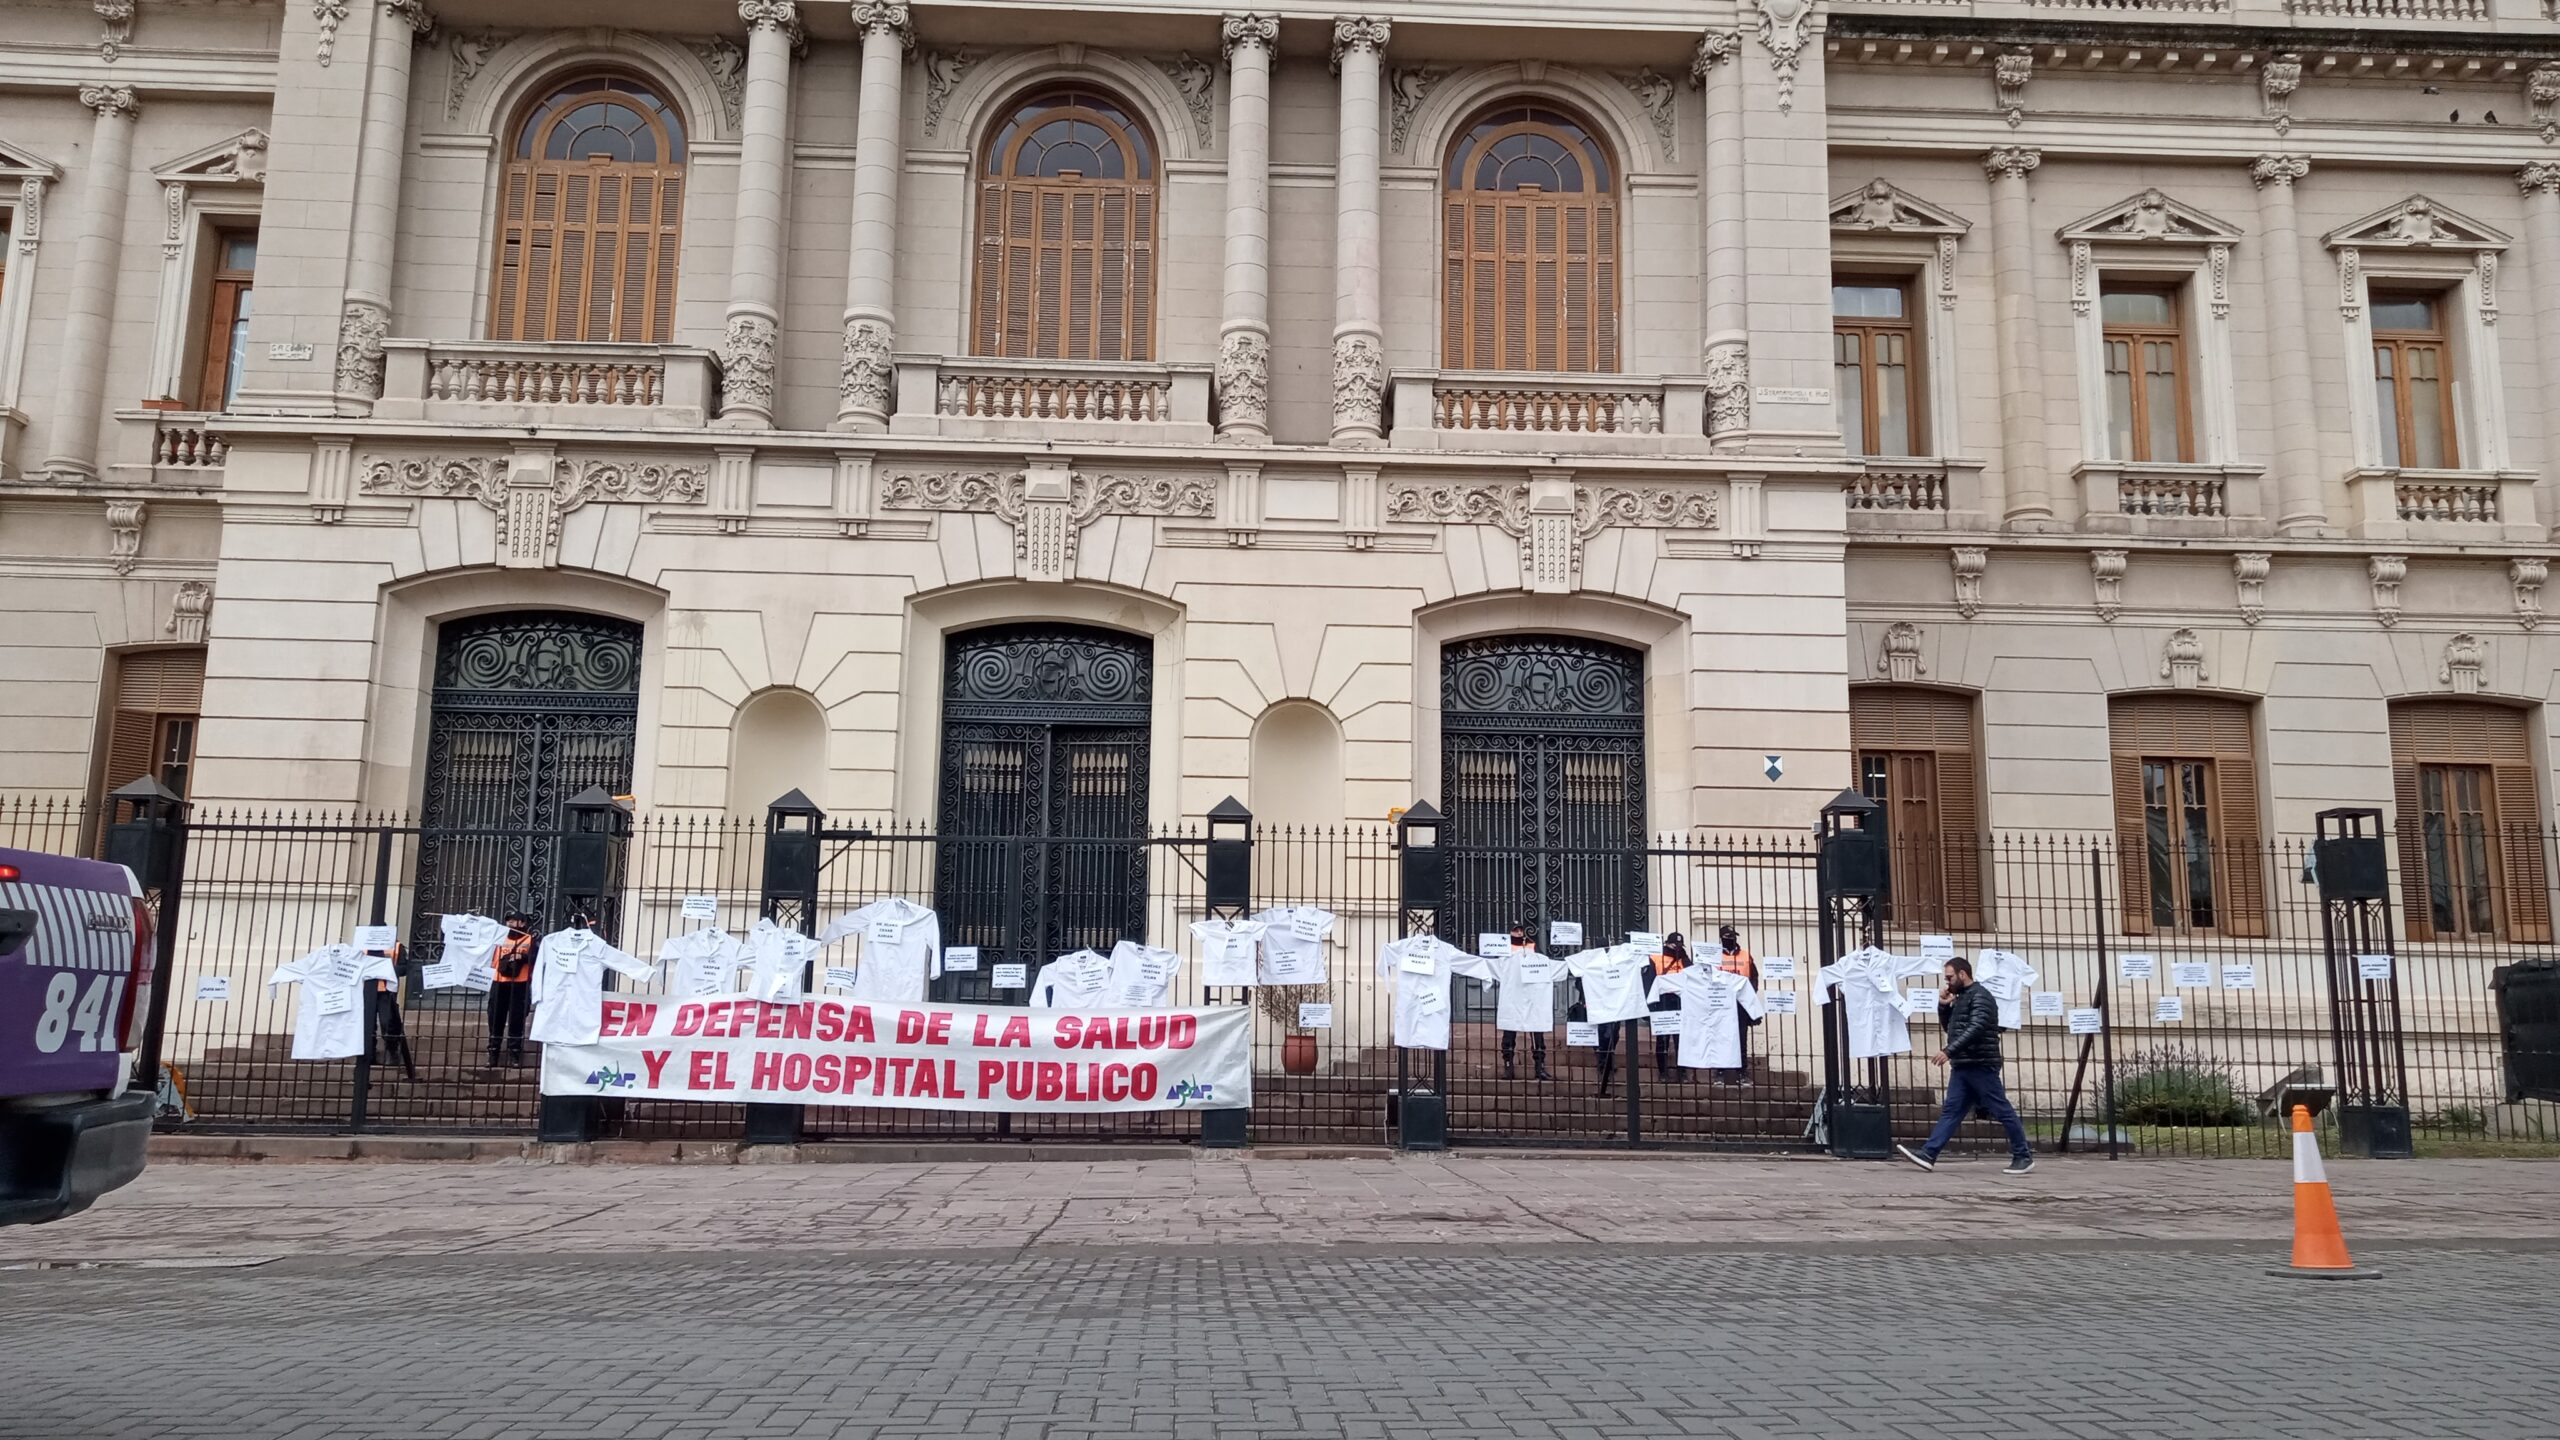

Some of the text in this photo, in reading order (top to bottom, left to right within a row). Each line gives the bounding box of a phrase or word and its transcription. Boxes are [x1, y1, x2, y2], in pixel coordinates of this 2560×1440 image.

[35, 972, 126, 1053] 841
[600, 1000, 1197, 1050] EN DEFENSA DE LA SALUD
[641, 1051, 1158, 1102] Y EL HOSPITAL PUBLICO
